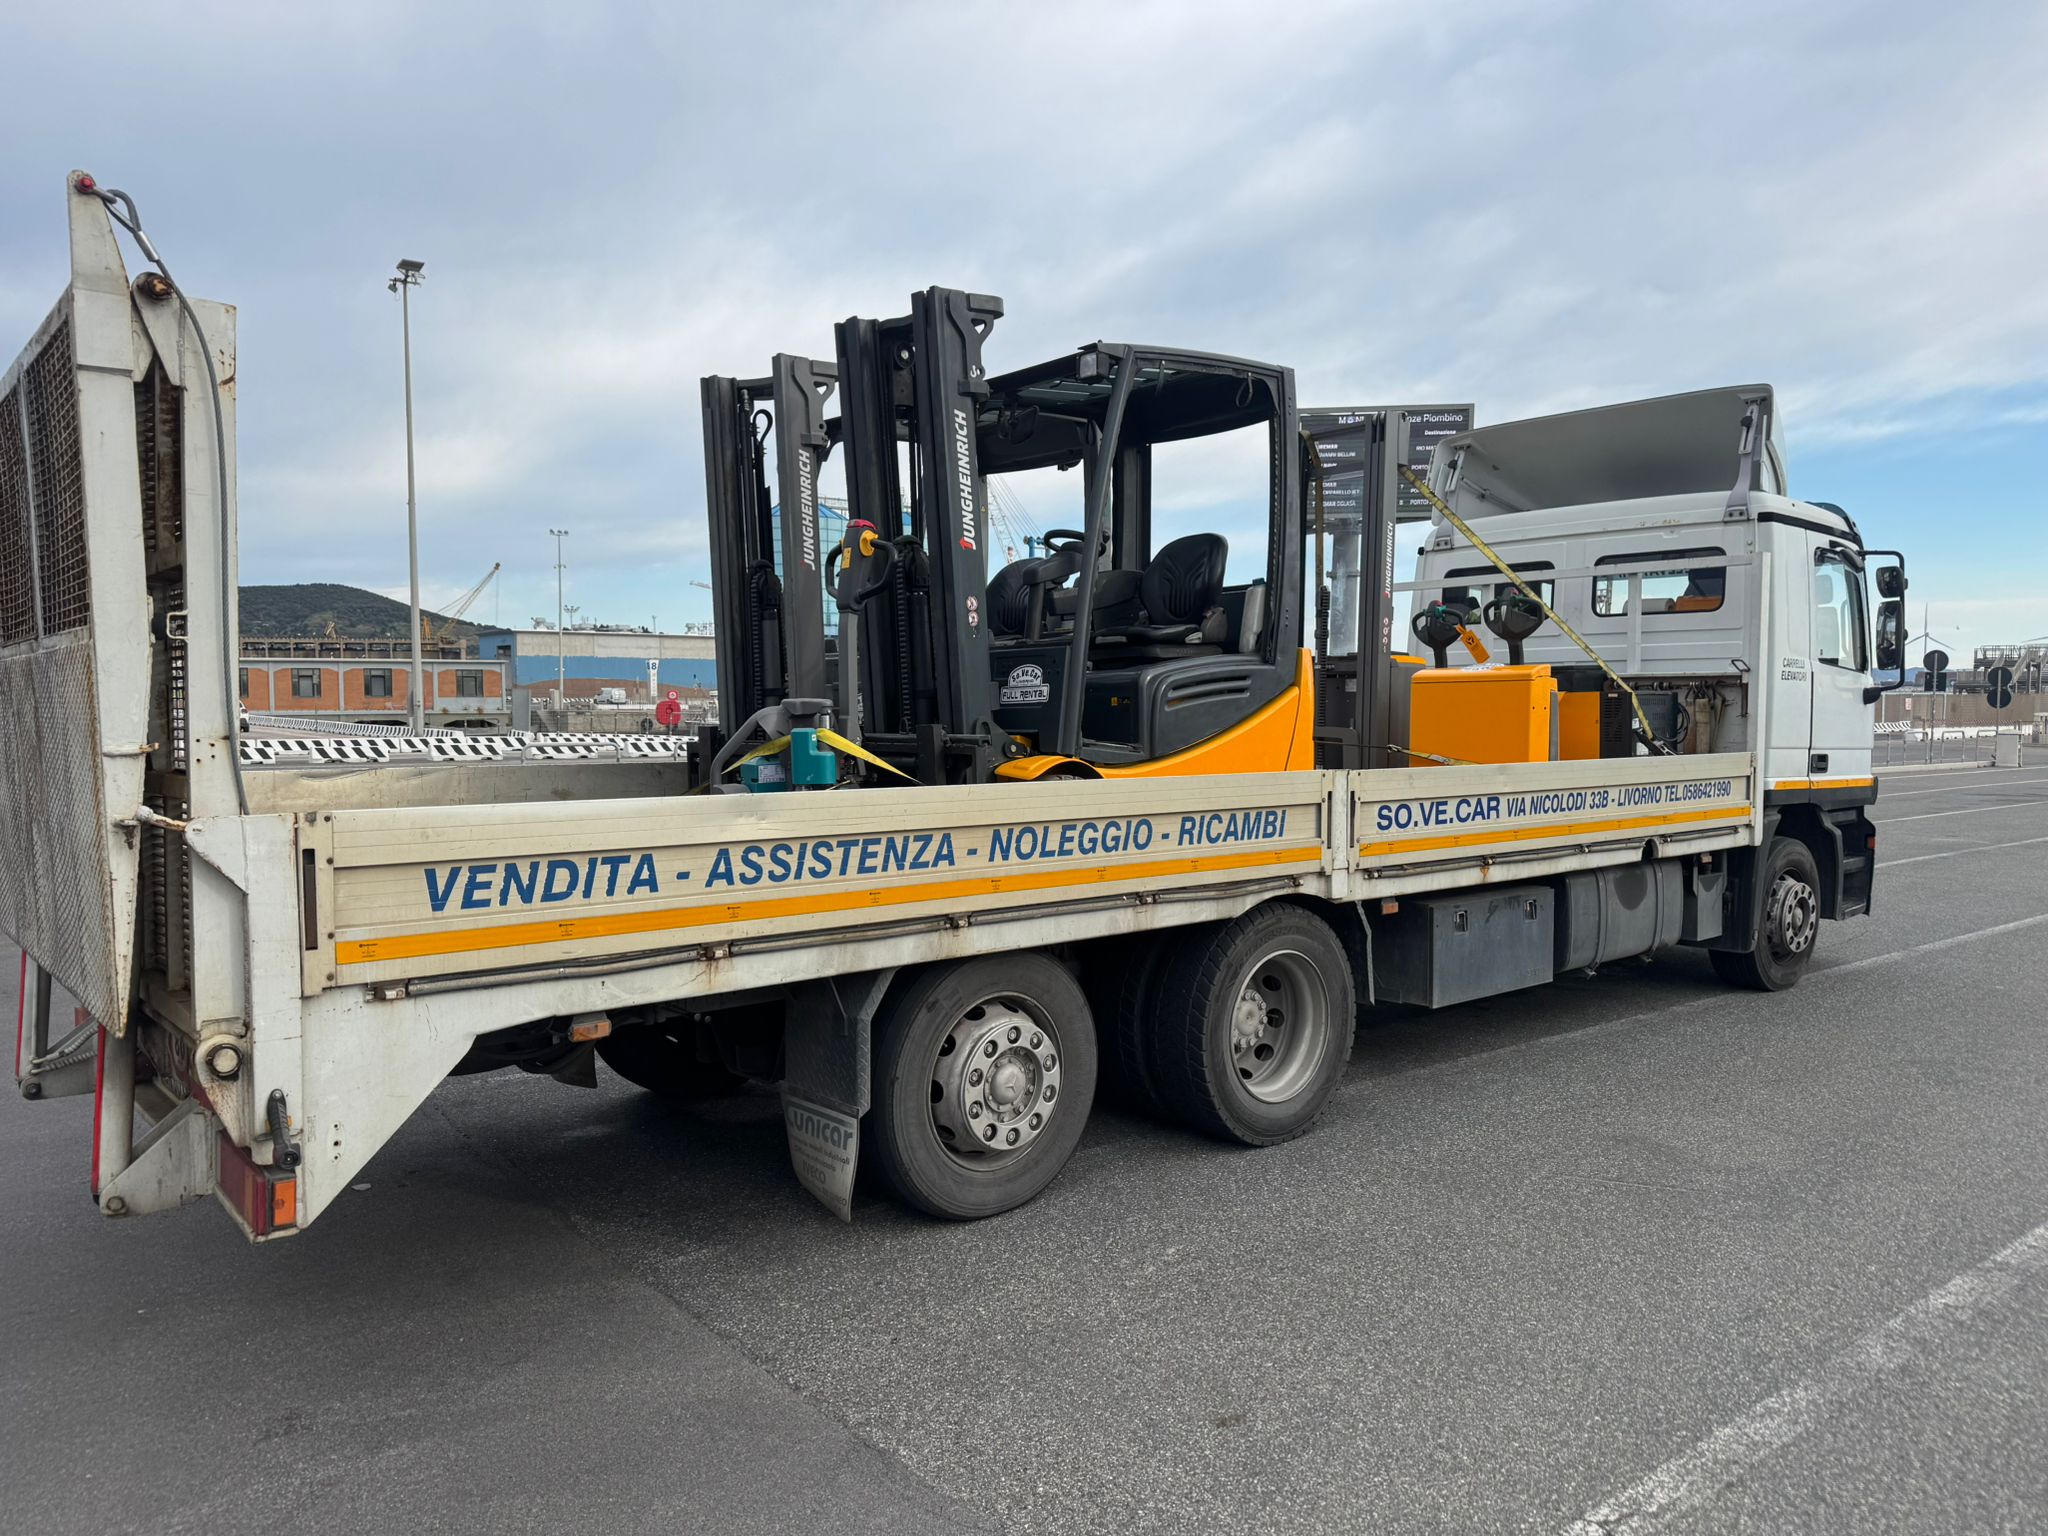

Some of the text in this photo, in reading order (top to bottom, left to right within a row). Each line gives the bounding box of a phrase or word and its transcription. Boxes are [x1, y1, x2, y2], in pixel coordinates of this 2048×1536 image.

[1423, 413, 1463, 423] Piombino
[798, 449, 816, 571] JUNGHEINRICH
[954, 408, 976, 551] JUNGHEINRICH
[1383, 521, 1394, 599] JUNGHEINRICH
[1003, 691, 1018, 700] FULL
[1376, 796, 1500, 831] SO.VE.CAR
[1507, 797, 1526, 818] VIA
[1529, 791, 1588, 815] NICOLODI
[1589, 790, 1609, 810] 33B
[1617, 785, 1662, 807] LIVORNO
[423, 853, 659, 913] VENDITA
[704, 832, 956, 889] ASSISTENZA
[988, 818, 1154, 863] NOLEGGIO
[1177, 810, 1287, 847] RICAMBI
